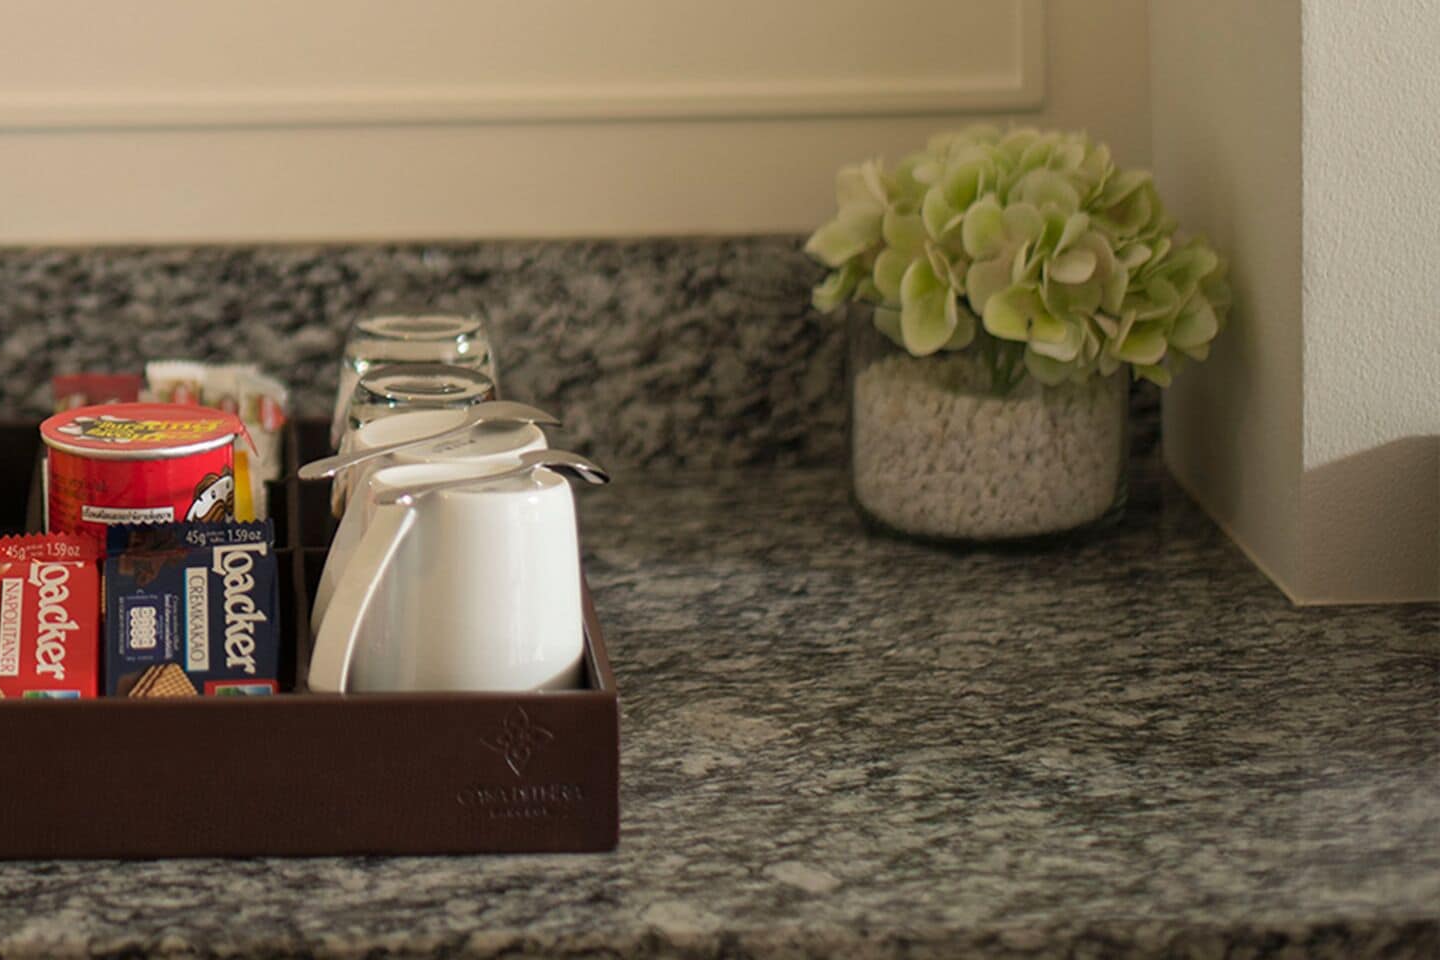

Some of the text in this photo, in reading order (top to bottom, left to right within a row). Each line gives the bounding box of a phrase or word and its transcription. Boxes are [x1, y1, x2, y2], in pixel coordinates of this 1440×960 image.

[185, 529, 207, 546] 45g
[1, 581, 19, 673] NAPOLITANER
[28, 559, 84, 680] Loacker
[189, 575, 206, 662] CREMKAKAO
[212, 541, 267, 673] Loacker
